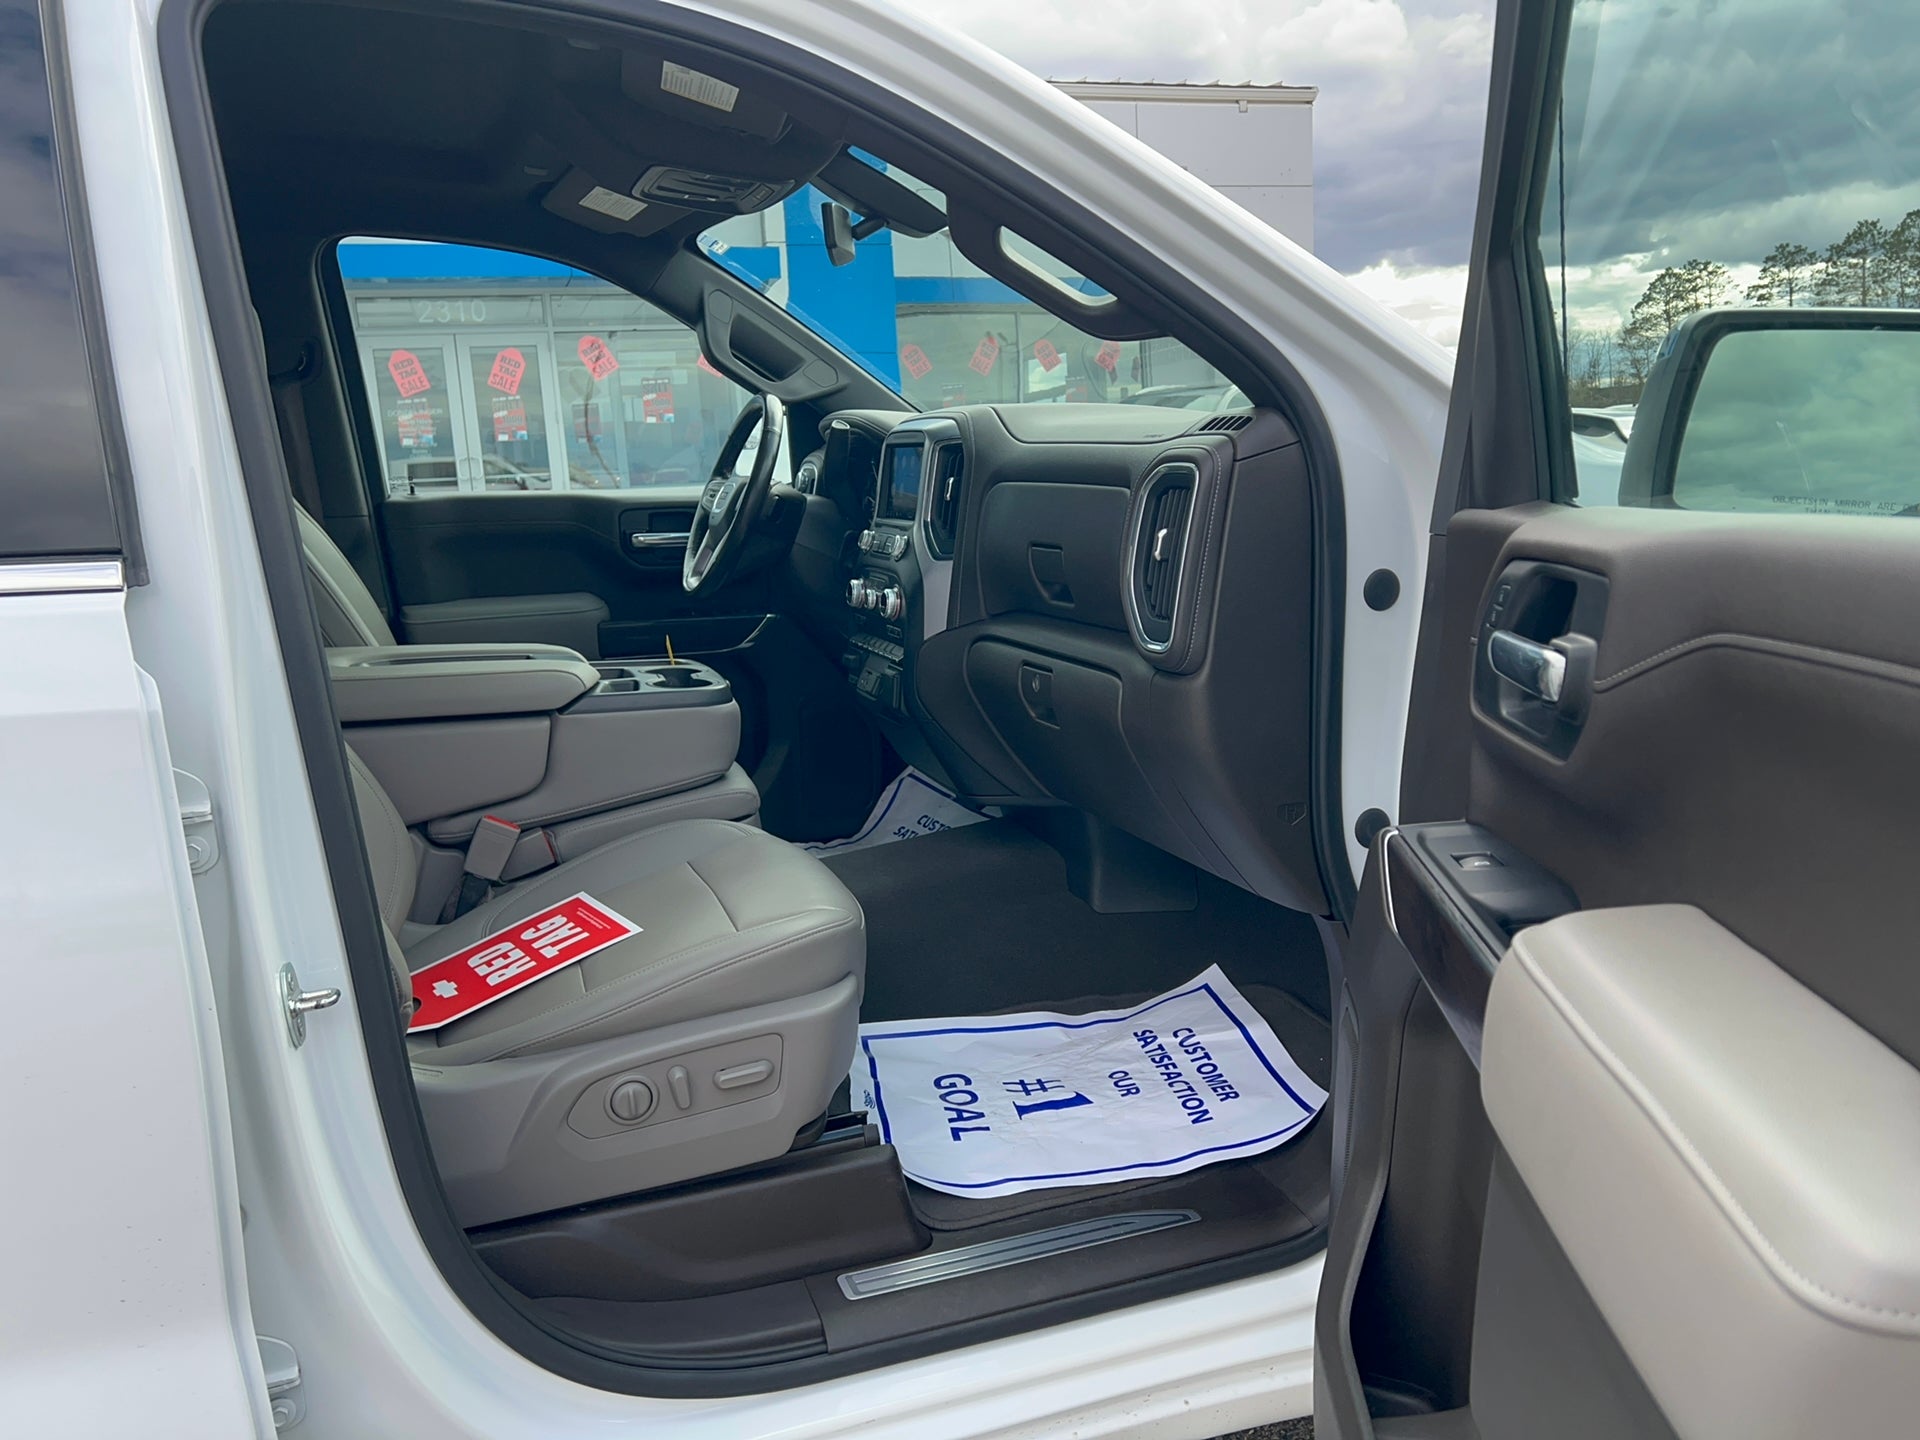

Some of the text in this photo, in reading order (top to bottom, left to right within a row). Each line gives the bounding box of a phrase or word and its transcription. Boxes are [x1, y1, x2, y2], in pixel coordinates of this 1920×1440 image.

[418, 300, 486, 323] 2310
[393, 359, 414, 371] RED
[499, 364, 518, 378] TAG
[500, 355, 521, 369] RED
[592, 357, 617, 377] SALE
[398, 367, 418, 380] TAG
[490, 373, 517, 392] SALE
[401, 376, 427, 394] SALE
[1772, 495, 1814, 506] OBJECTS
[1834, 499, 1872, 509] MIRROR
[1877, 502, 1897, 511] ARE
[520, 914, 590, 959] TAG
[467, 941, 537, 987] RED
[1172, 1027, 1240, 1103] CUSTOMER
[1108, 1070, 1141, 1098] OUR
[1133, 1029, 1214, 1125] SATISFACTION
[933, 1073, 991, 1142] GOAL
[1002, 1078, 1094, 1121] #1
